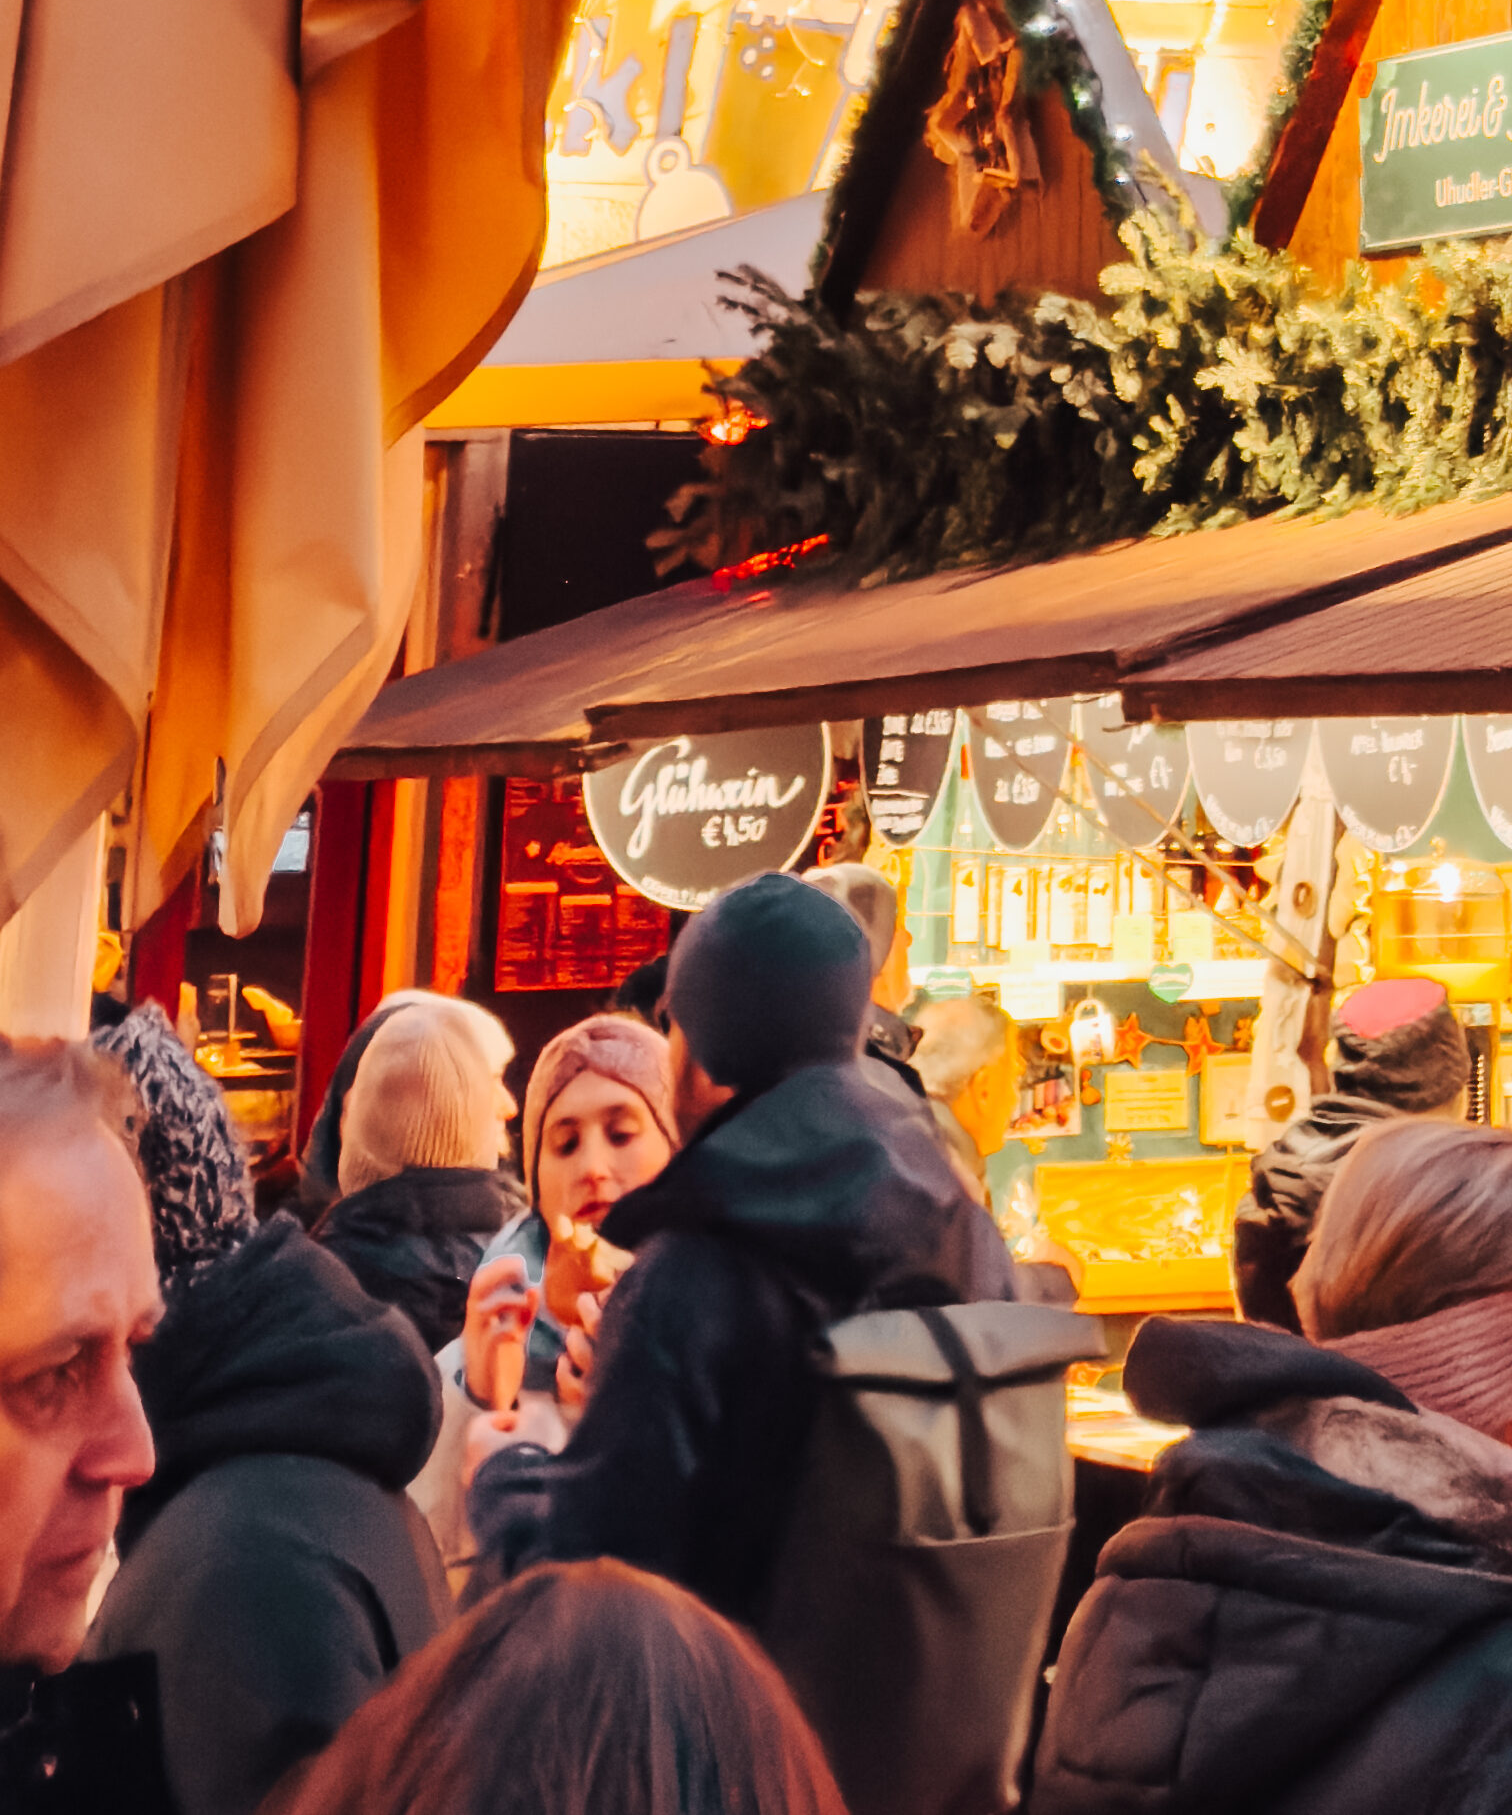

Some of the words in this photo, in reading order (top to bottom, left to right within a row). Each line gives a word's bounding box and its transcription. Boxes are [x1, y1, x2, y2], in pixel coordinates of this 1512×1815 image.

[1373, 80, 1483, 163] Imkerei
[1482, 74, 1507, 139] &
[619, 734, 807, 860] Glühwein
